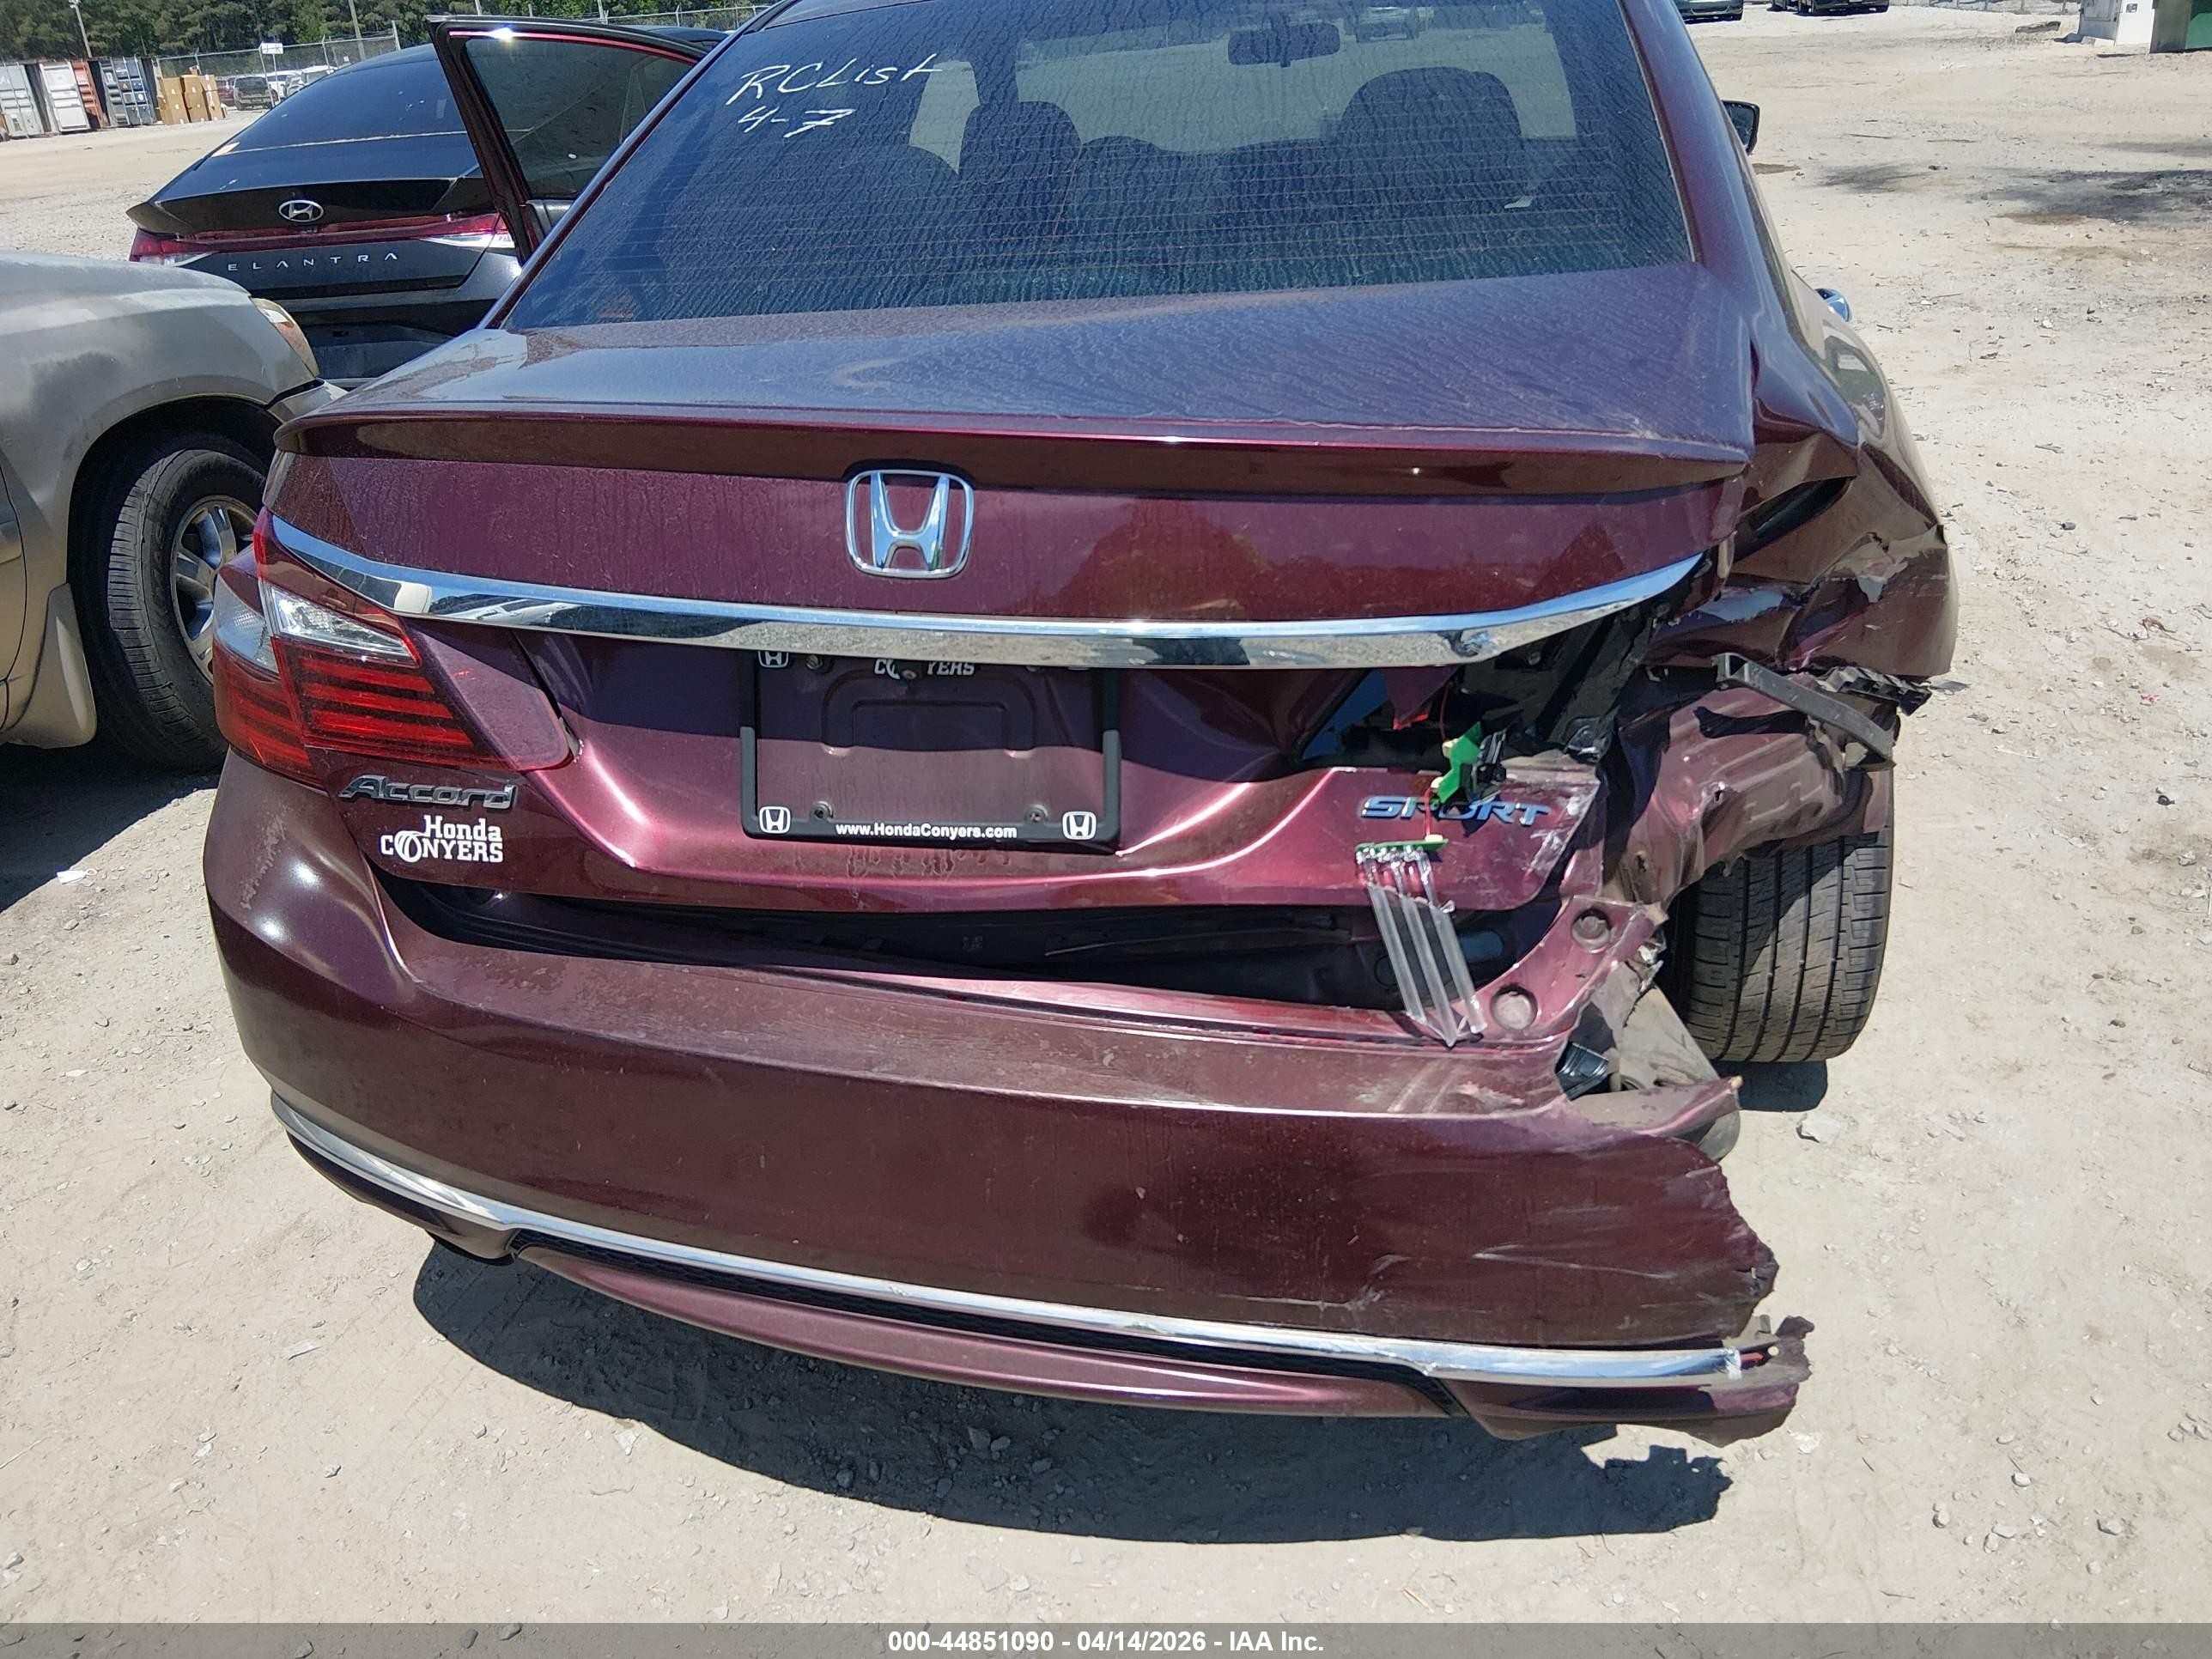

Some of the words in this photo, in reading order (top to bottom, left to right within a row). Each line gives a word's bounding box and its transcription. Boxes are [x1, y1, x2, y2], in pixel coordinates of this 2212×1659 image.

[228, 252, 398, 271] ELANTRA
[338, 775, 519, 810] Accord
[1361, 795, 1552, 827] SPORT
[423, 815, 503, 842] Honda
[836, 822, 1018, 841] www.HondaConyers.com
[380, 830, 504, 863] CONYERS
